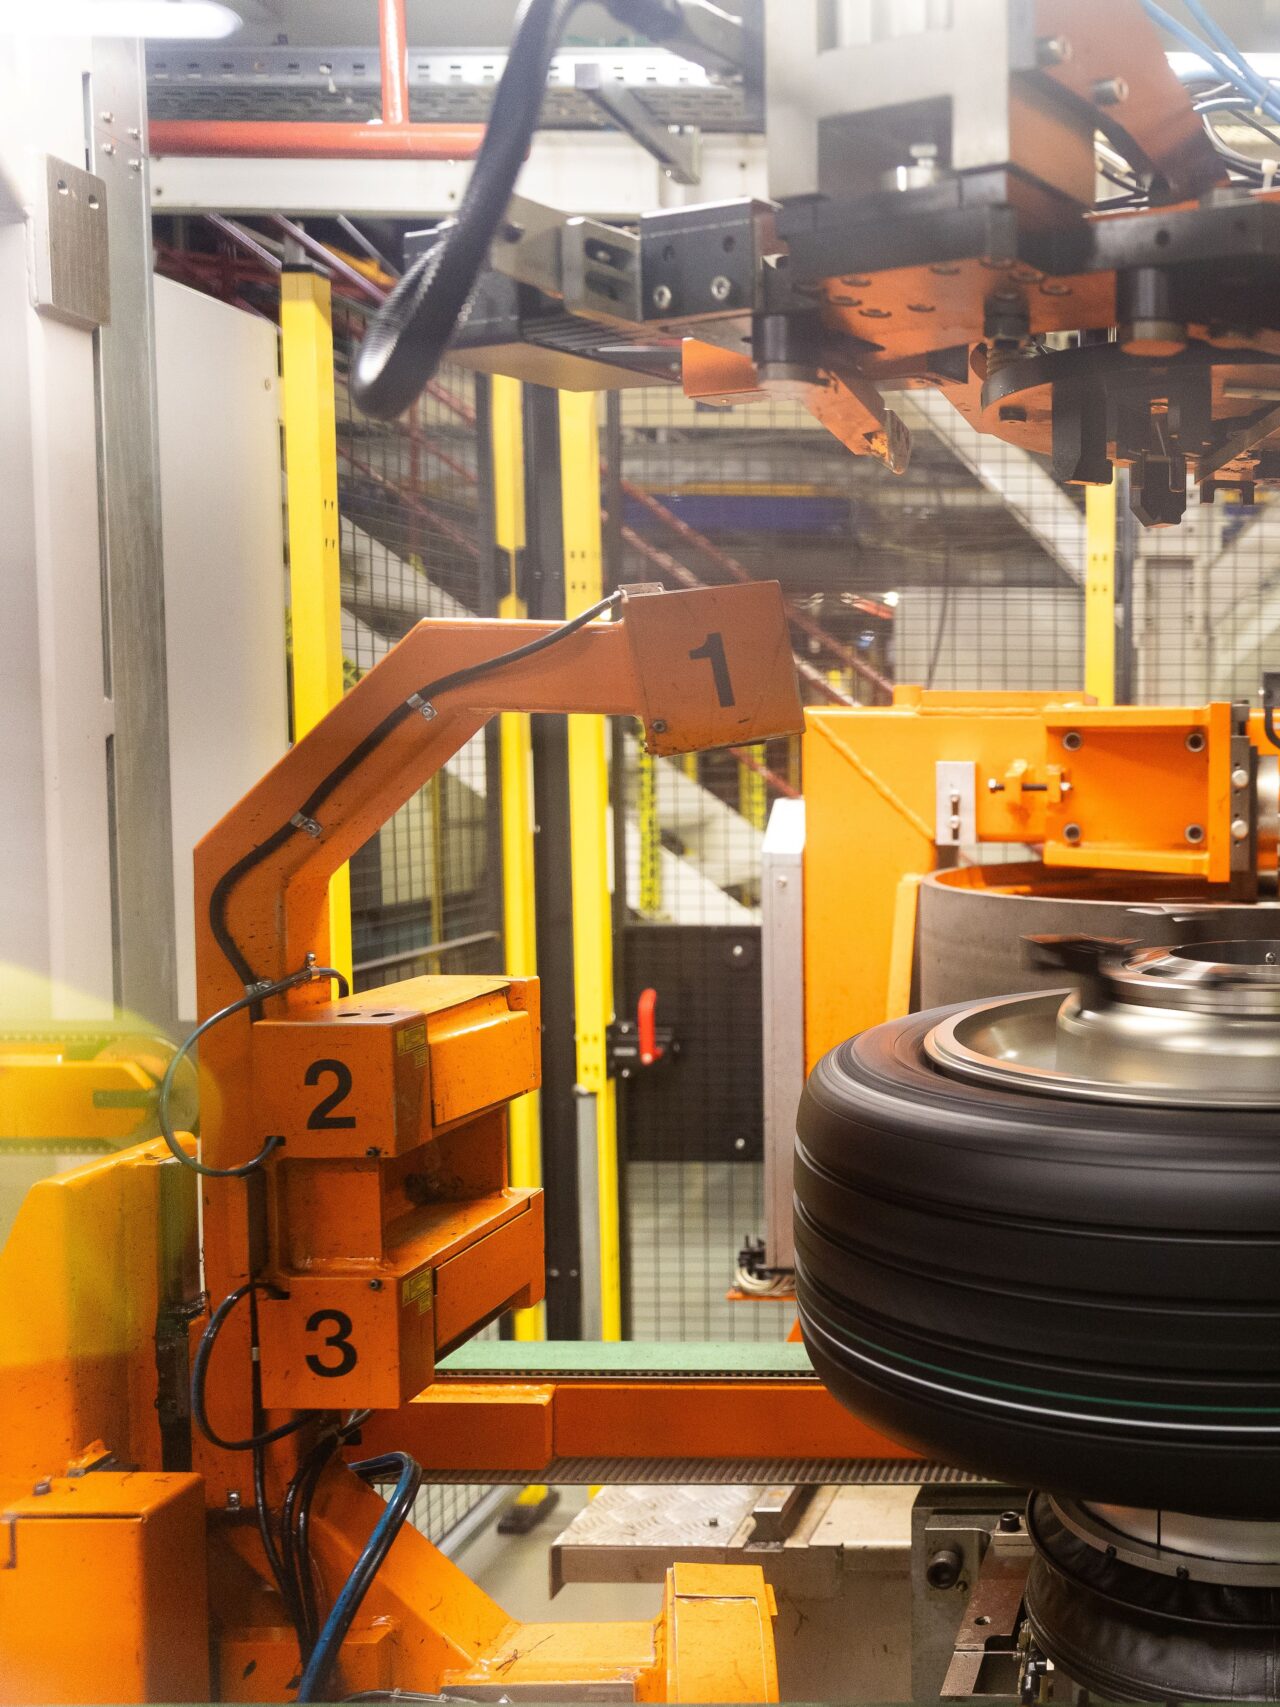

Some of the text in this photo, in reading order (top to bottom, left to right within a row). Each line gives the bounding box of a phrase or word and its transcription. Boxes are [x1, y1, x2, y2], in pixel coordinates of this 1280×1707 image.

[689, 632, 735, 707] 1
[304, 1059, 356, 1130] 2
[305, 1309, 357, 1377] 3
